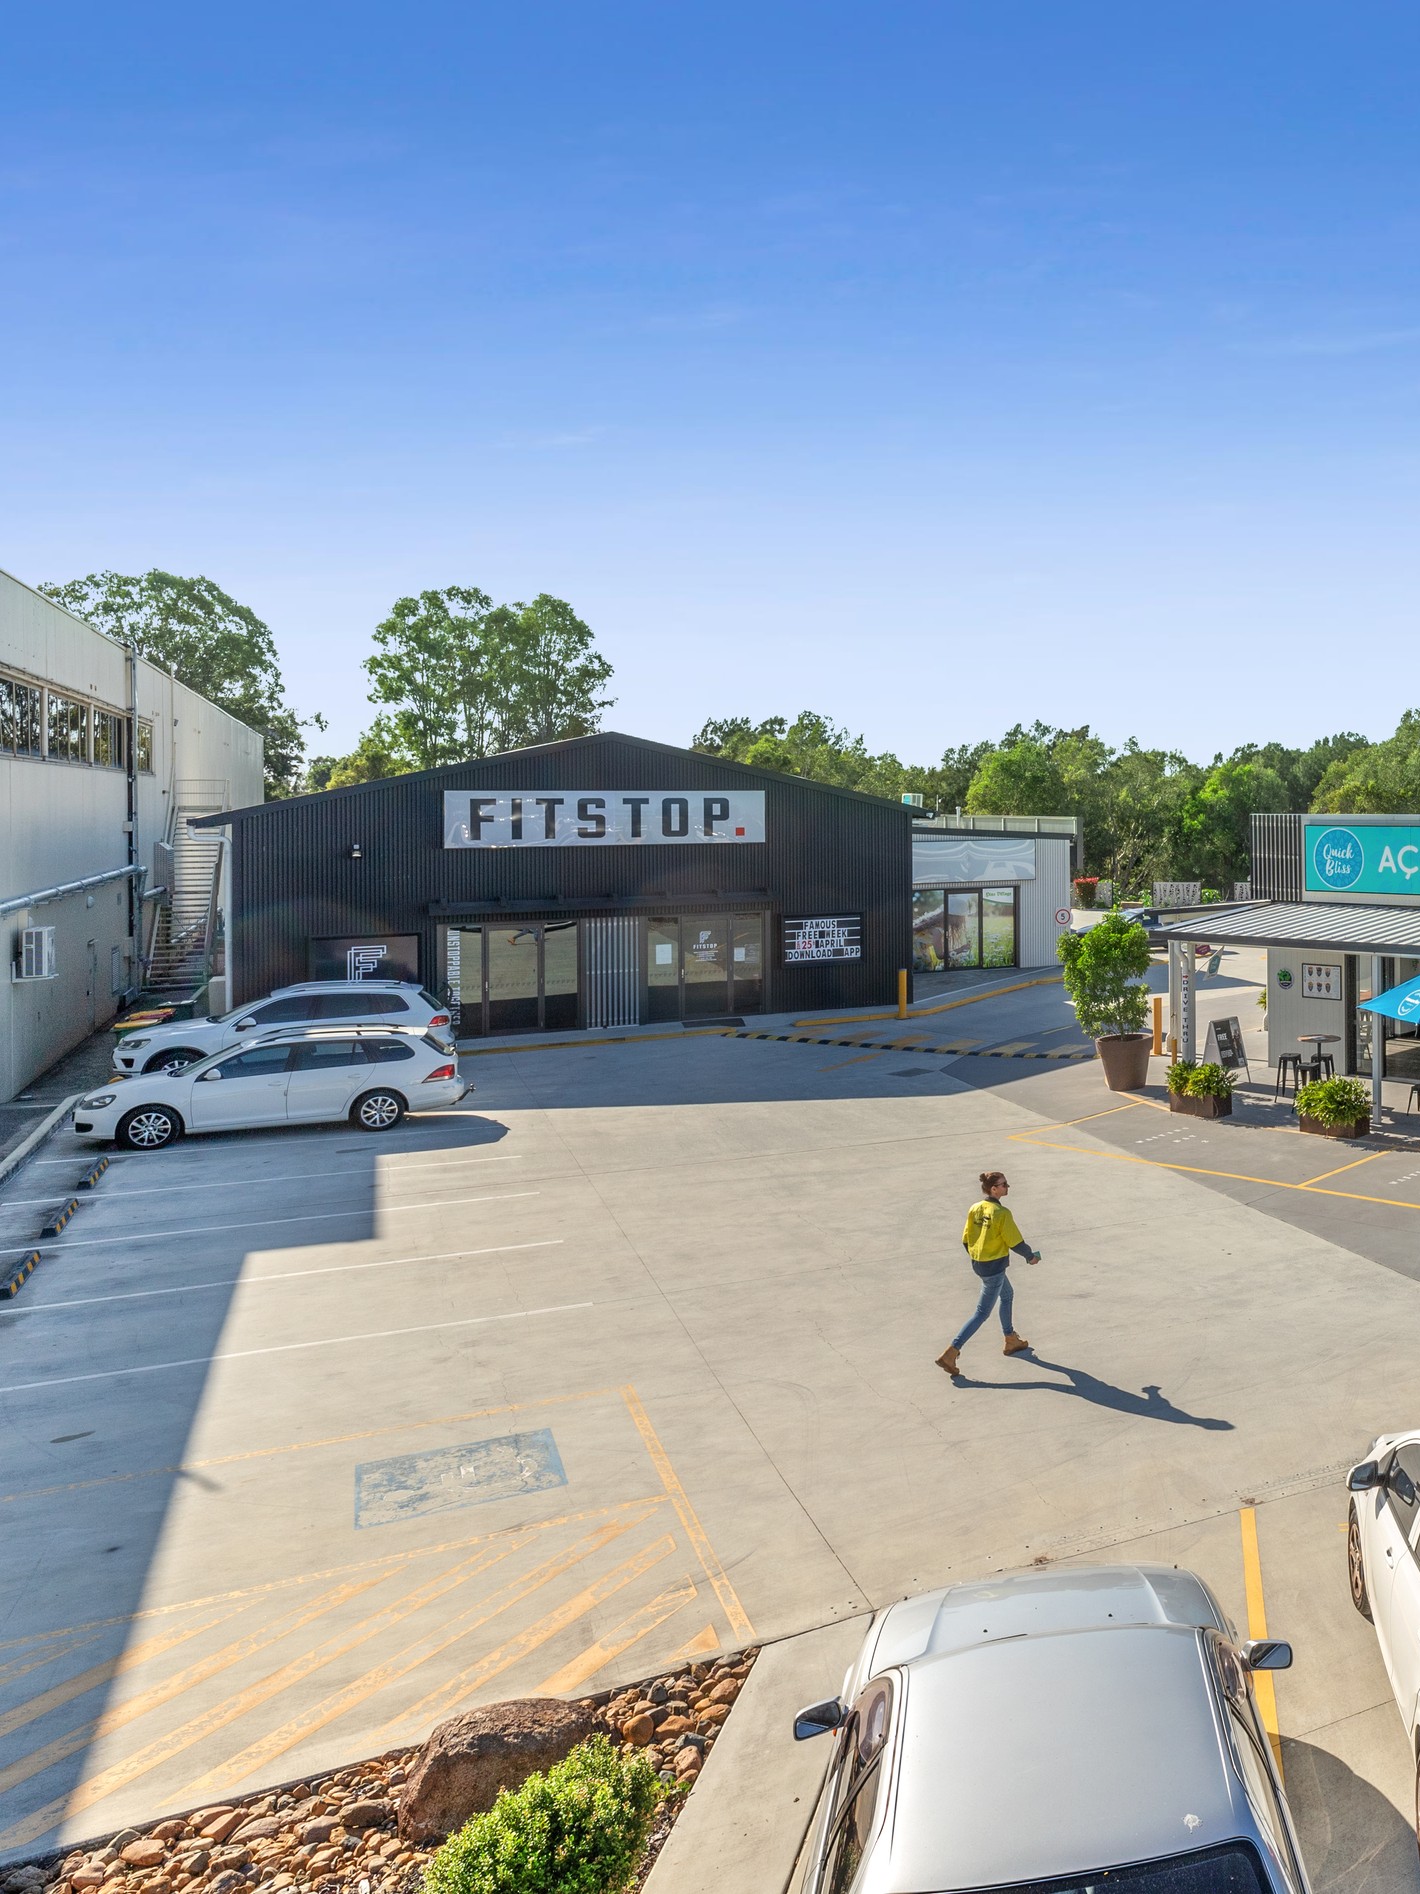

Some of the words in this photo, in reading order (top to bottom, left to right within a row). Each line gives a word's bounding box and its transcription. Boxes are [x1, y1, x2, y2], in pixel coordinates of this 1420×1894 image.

[1323, 843, 1355, 860] Quick
[1325, 860, 1351, 877] Bliss
[1061, 913, 1066, 921] 5
[804, 920, 836, 930] FAMOUS
[796, 931, 818, 940] FREE
[820, 939, 844, 949] APRIL
[447, 930, 460, 985] UNSTOPPABLE
[788, 949, 832, 960] DOWNLOAD
[844, 947, 860, 956] APP
